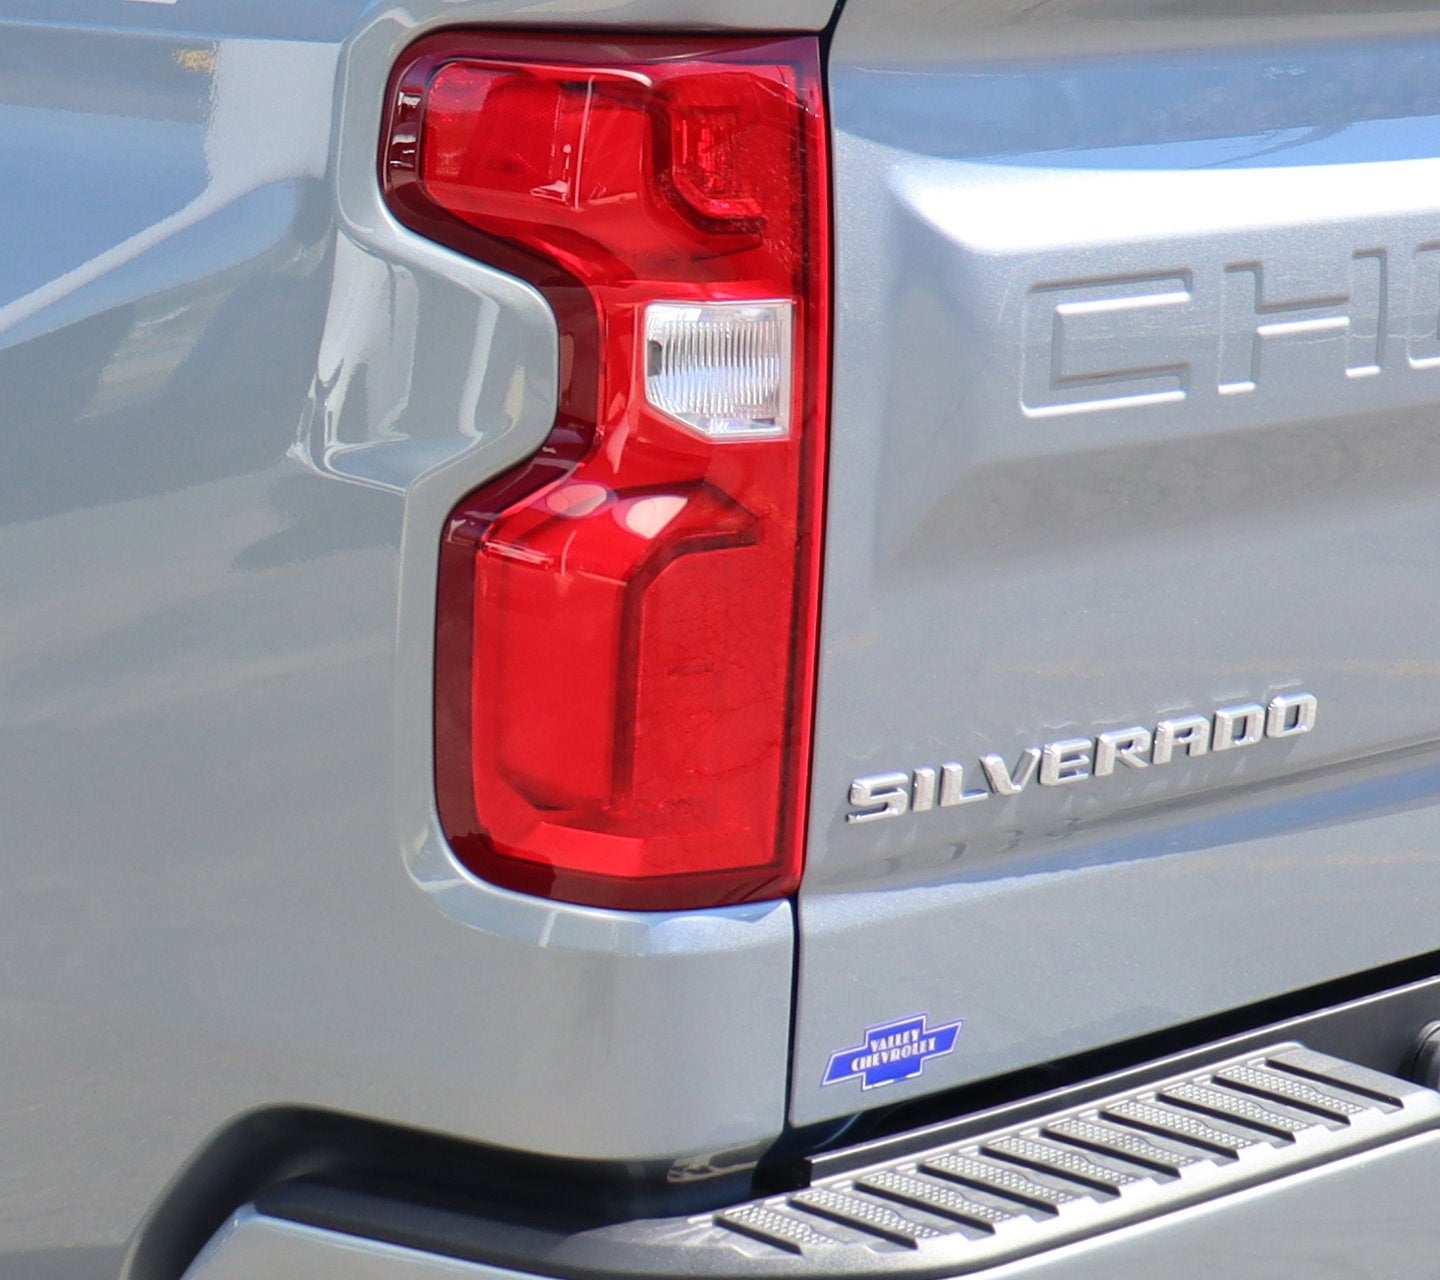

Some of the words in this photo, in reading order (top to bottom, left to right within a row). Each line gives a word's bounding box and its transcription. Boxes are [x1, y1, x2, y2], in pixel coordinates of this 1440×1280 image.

[846, 691, 1318, 824] SILVERADO
[850, 1037, 937, 1072] CHEVROLET
[870, 1028, 920, 1053] VALLEY
